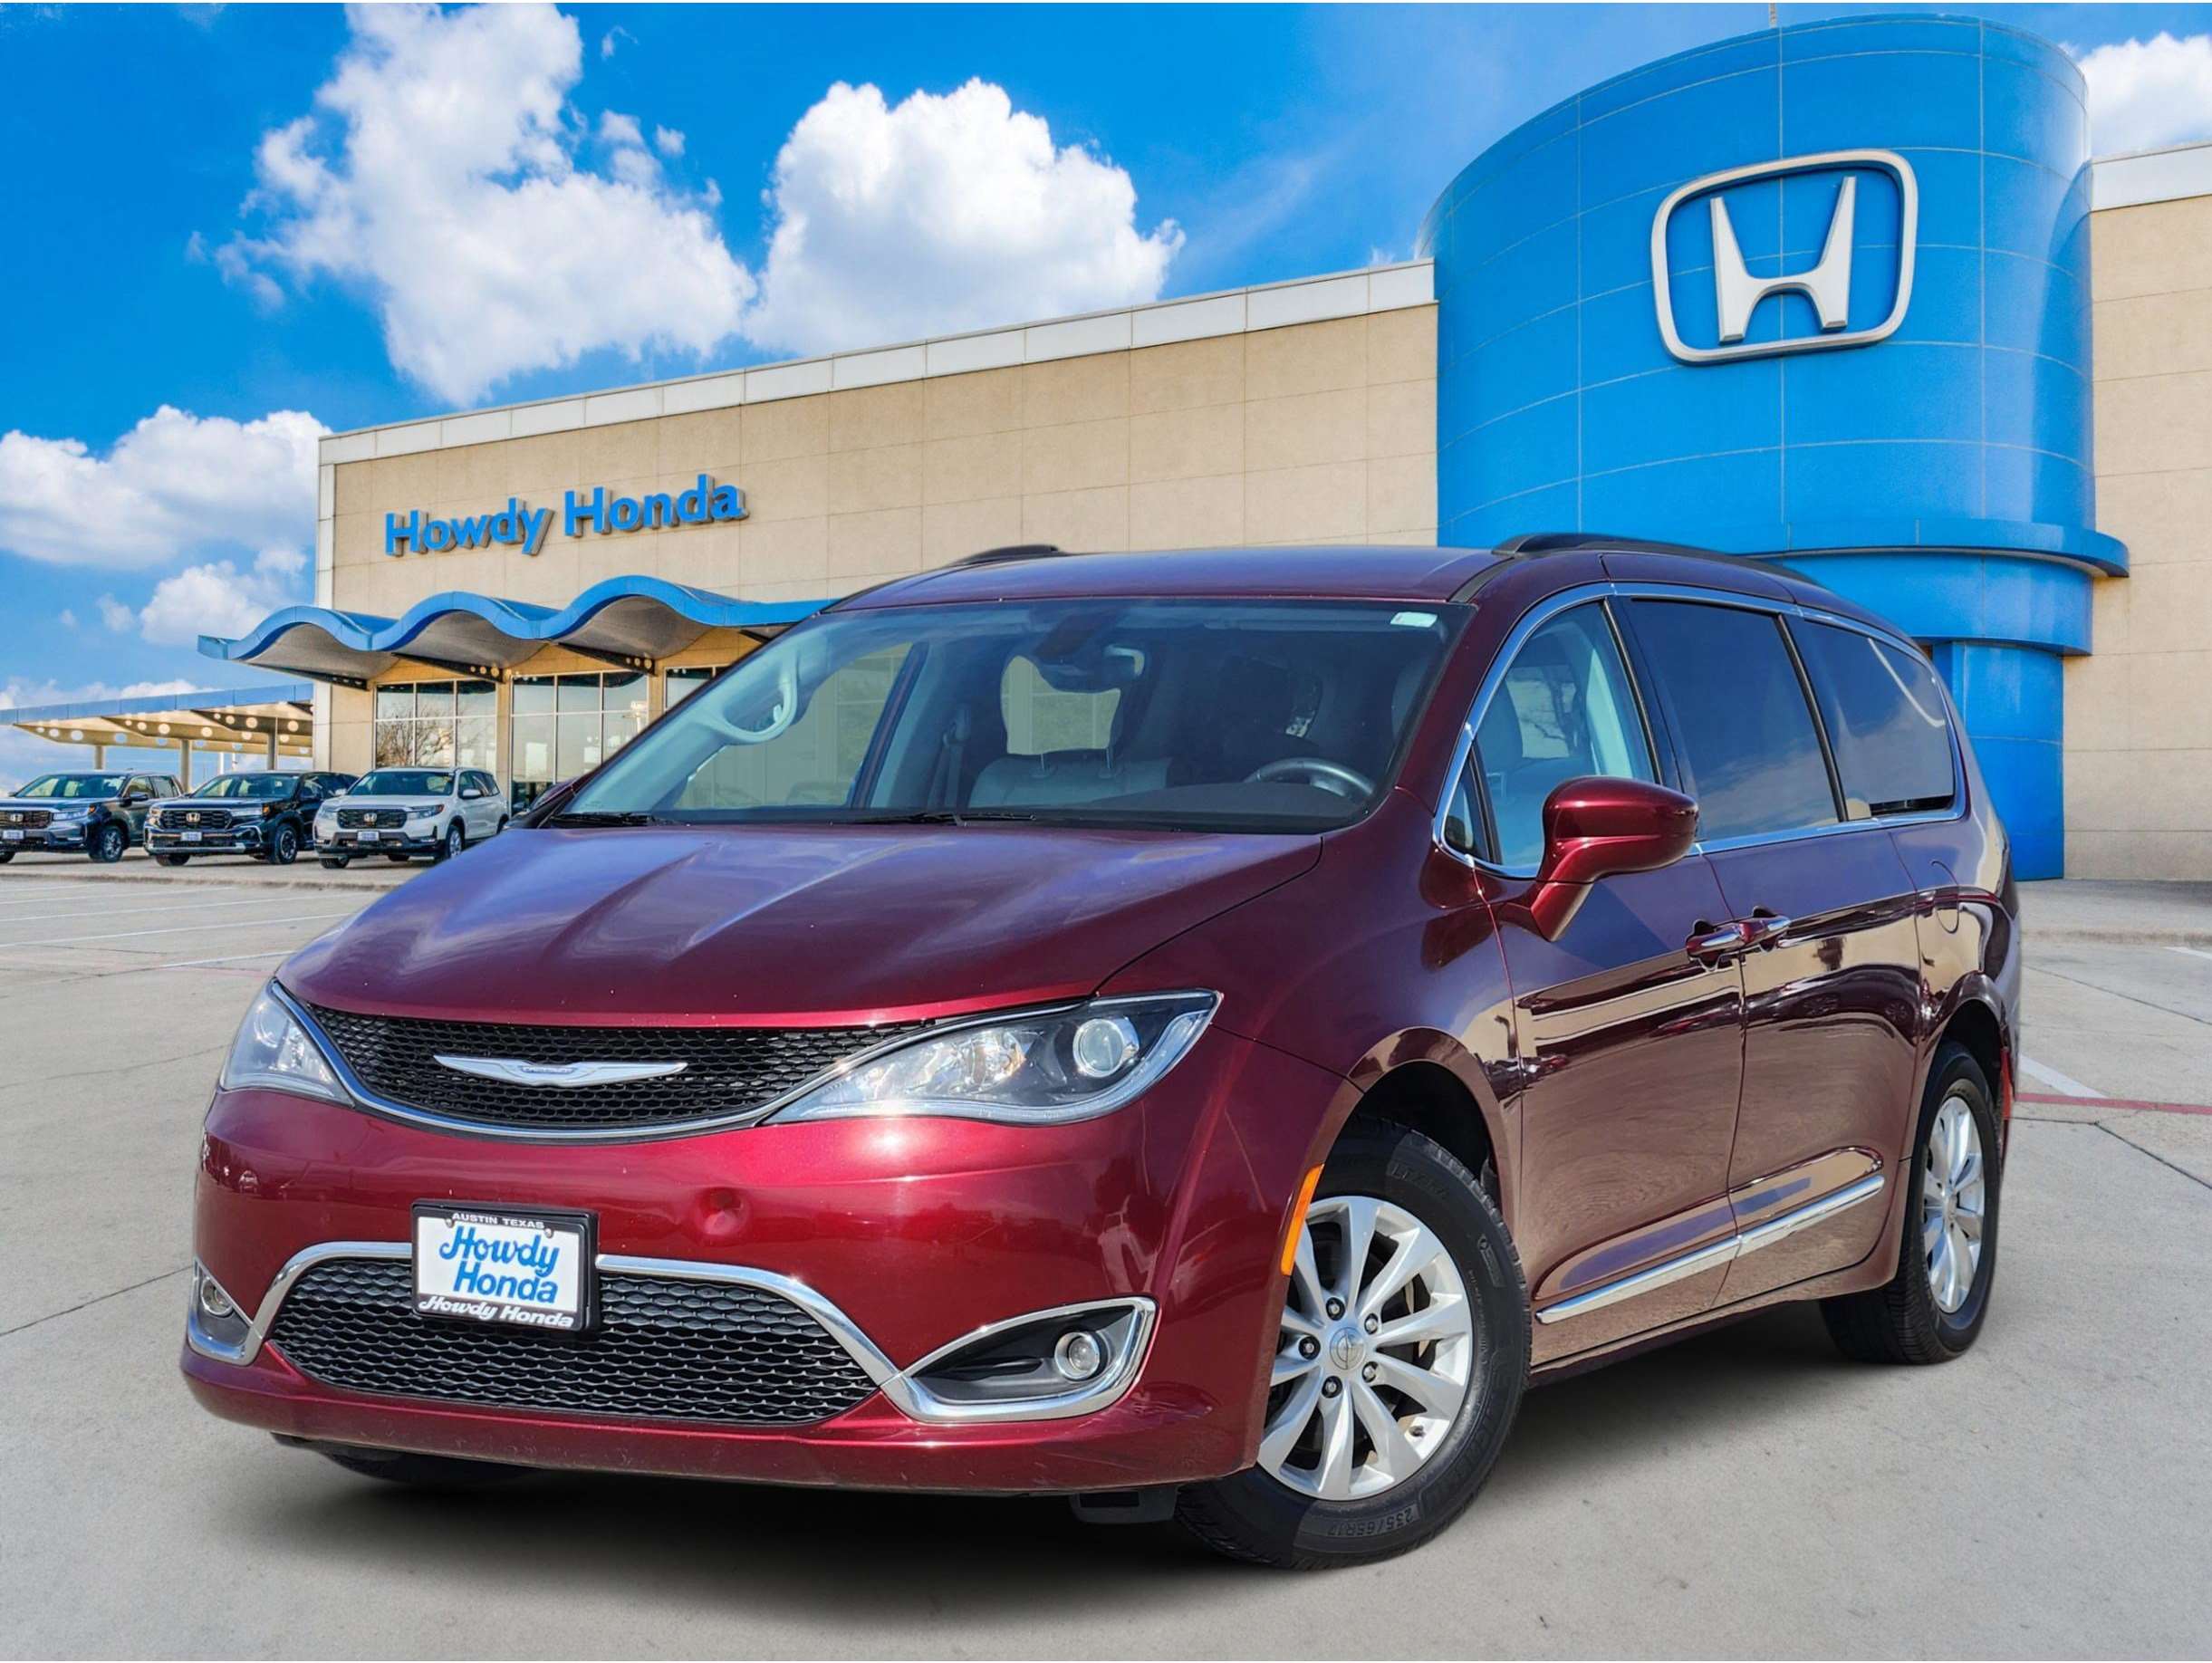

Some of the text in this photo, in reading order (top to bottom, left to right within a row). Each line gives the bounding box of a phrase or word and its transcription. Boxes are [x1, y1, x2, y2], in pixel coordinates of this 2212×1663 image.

[384, 473, 749, 557] Howdy Honda
[452, 1213, 545, 1229] AUSTIN TEXAS
[439, 1226, 560, 1278] Howdy
[453, 1260, 559, 1304] Honda
[418, 1295, 574, 1328] Howdy Honda
